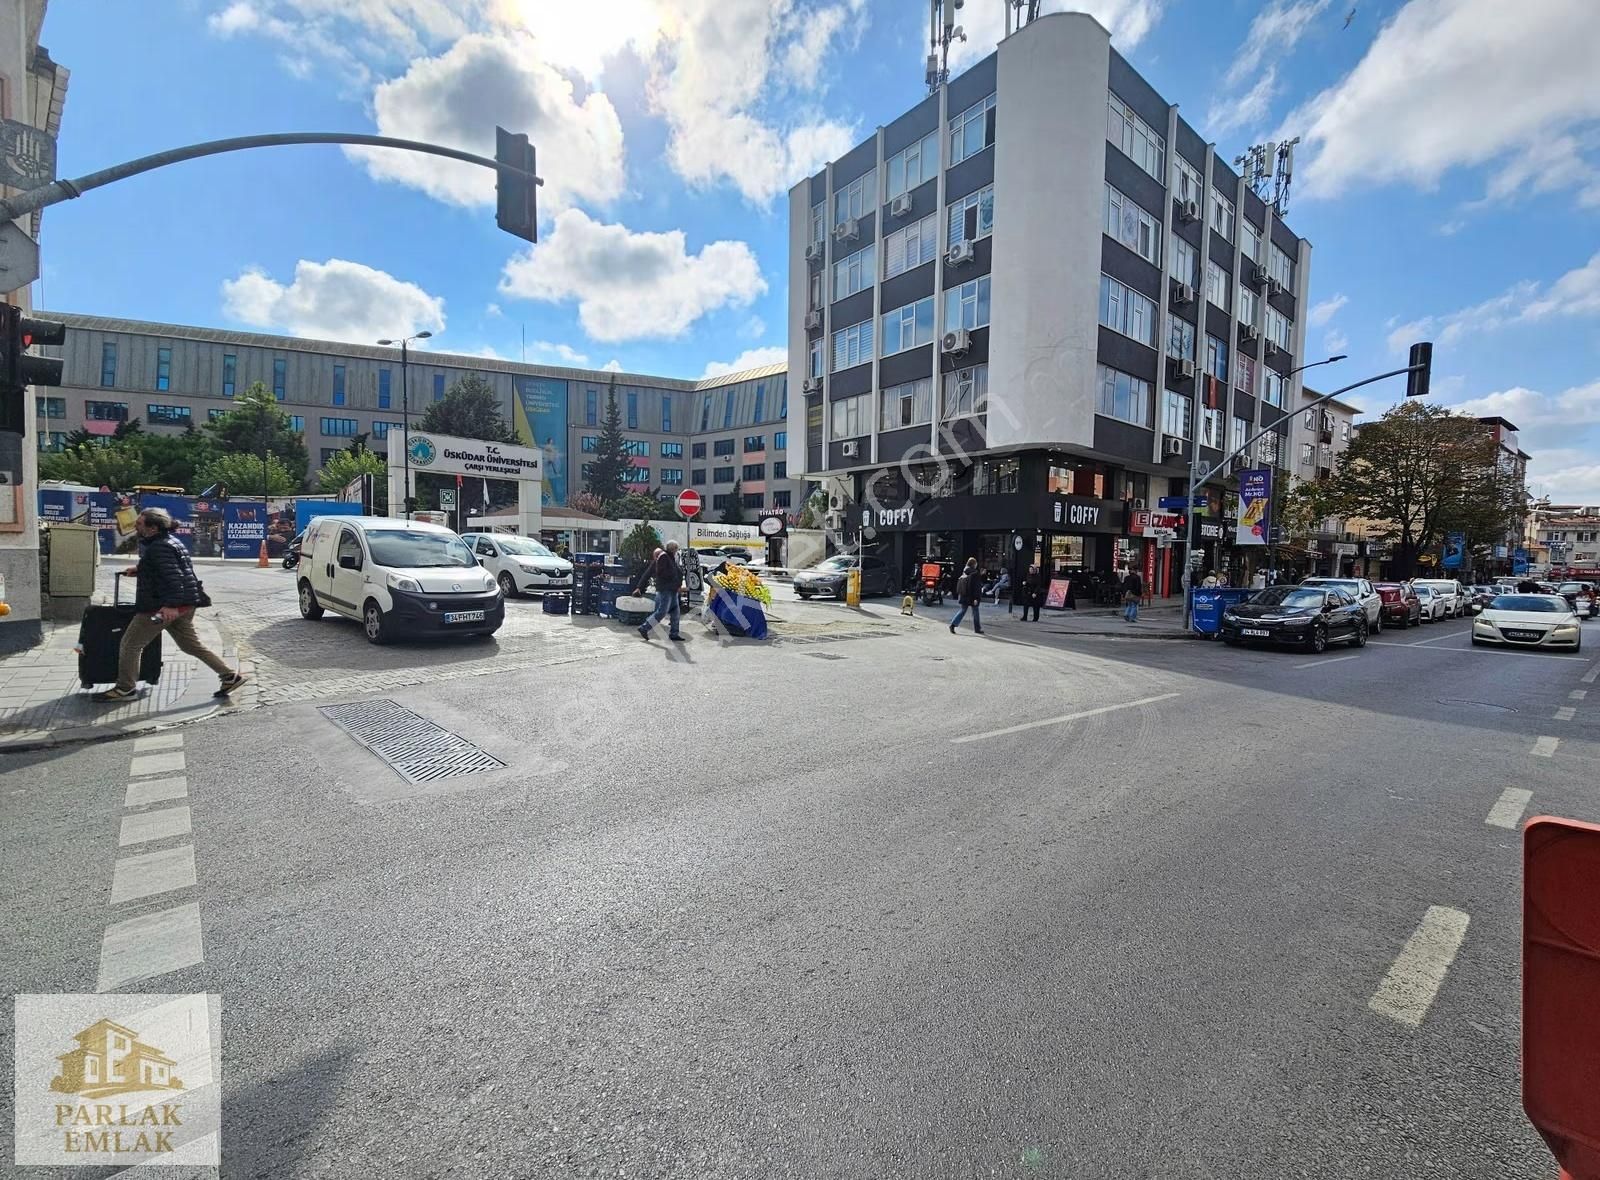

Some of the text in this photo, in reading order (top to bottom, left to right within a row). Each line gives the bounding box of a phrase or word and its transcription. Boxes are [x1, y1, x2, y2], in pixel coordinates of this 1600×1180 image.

[485, 446, 500, 455] T.C.
[443, 450, 538, 468] ÜSKÜDAR ÜNİVERSİTESİ
[464, 463, 521, 475] ÇARŞI YERLEŞKESİ
[879, 508, 915, 526] COFFY
[1070, 504, 1099, 526] COFFY
[697, 528, 751, 540] Bilimden Sağlığa
